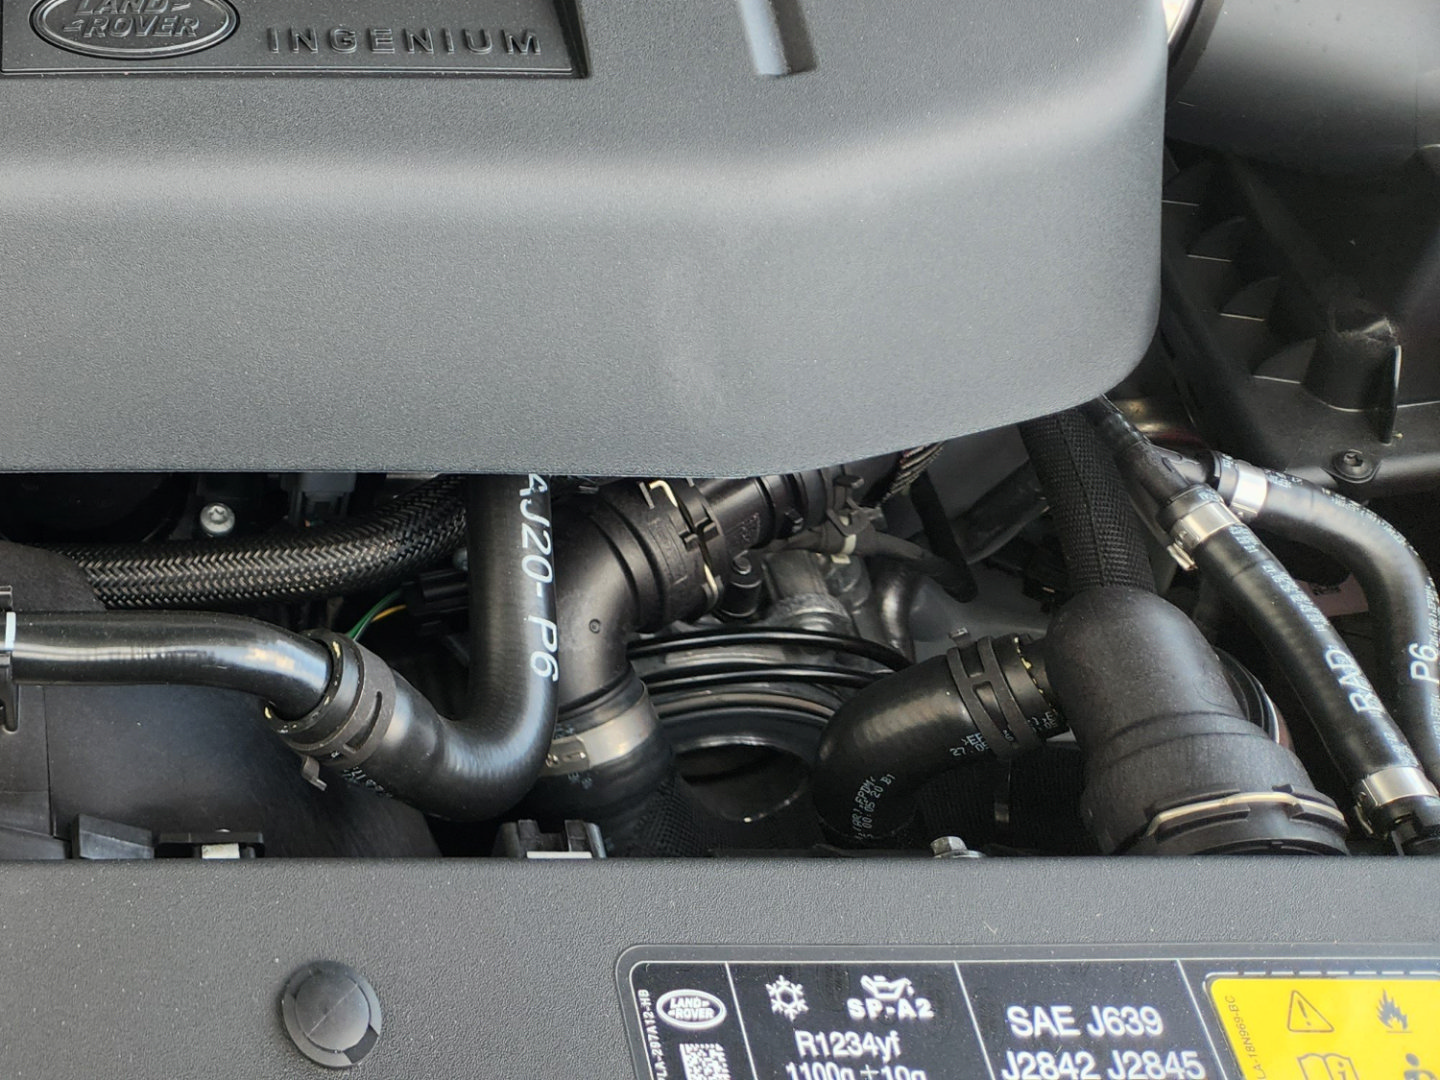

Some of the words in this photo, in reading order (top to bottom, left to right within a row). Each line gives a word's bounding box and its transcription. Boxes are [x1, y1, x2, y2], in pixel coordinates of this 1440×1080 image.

[267, 27, 542, 57] INGENIUM
[1408, 642, 1439, 684] P6
[1325, 649, 1386, 713] RAD
[670, 997, 703, 1008] LAND
[675, 1007, 716, 1020] ROVER
[846, 998, 935, 1020] SP-A2
[1006, 1005, 1081, 1037] SAE
[1086, 1005, 1164, 1037] J639
[794, 1030, 902, 1064] R1234yf
[1001, 1050, 1101, 1080] J2842
[1107, 1049, 1206, 1080] J2845
